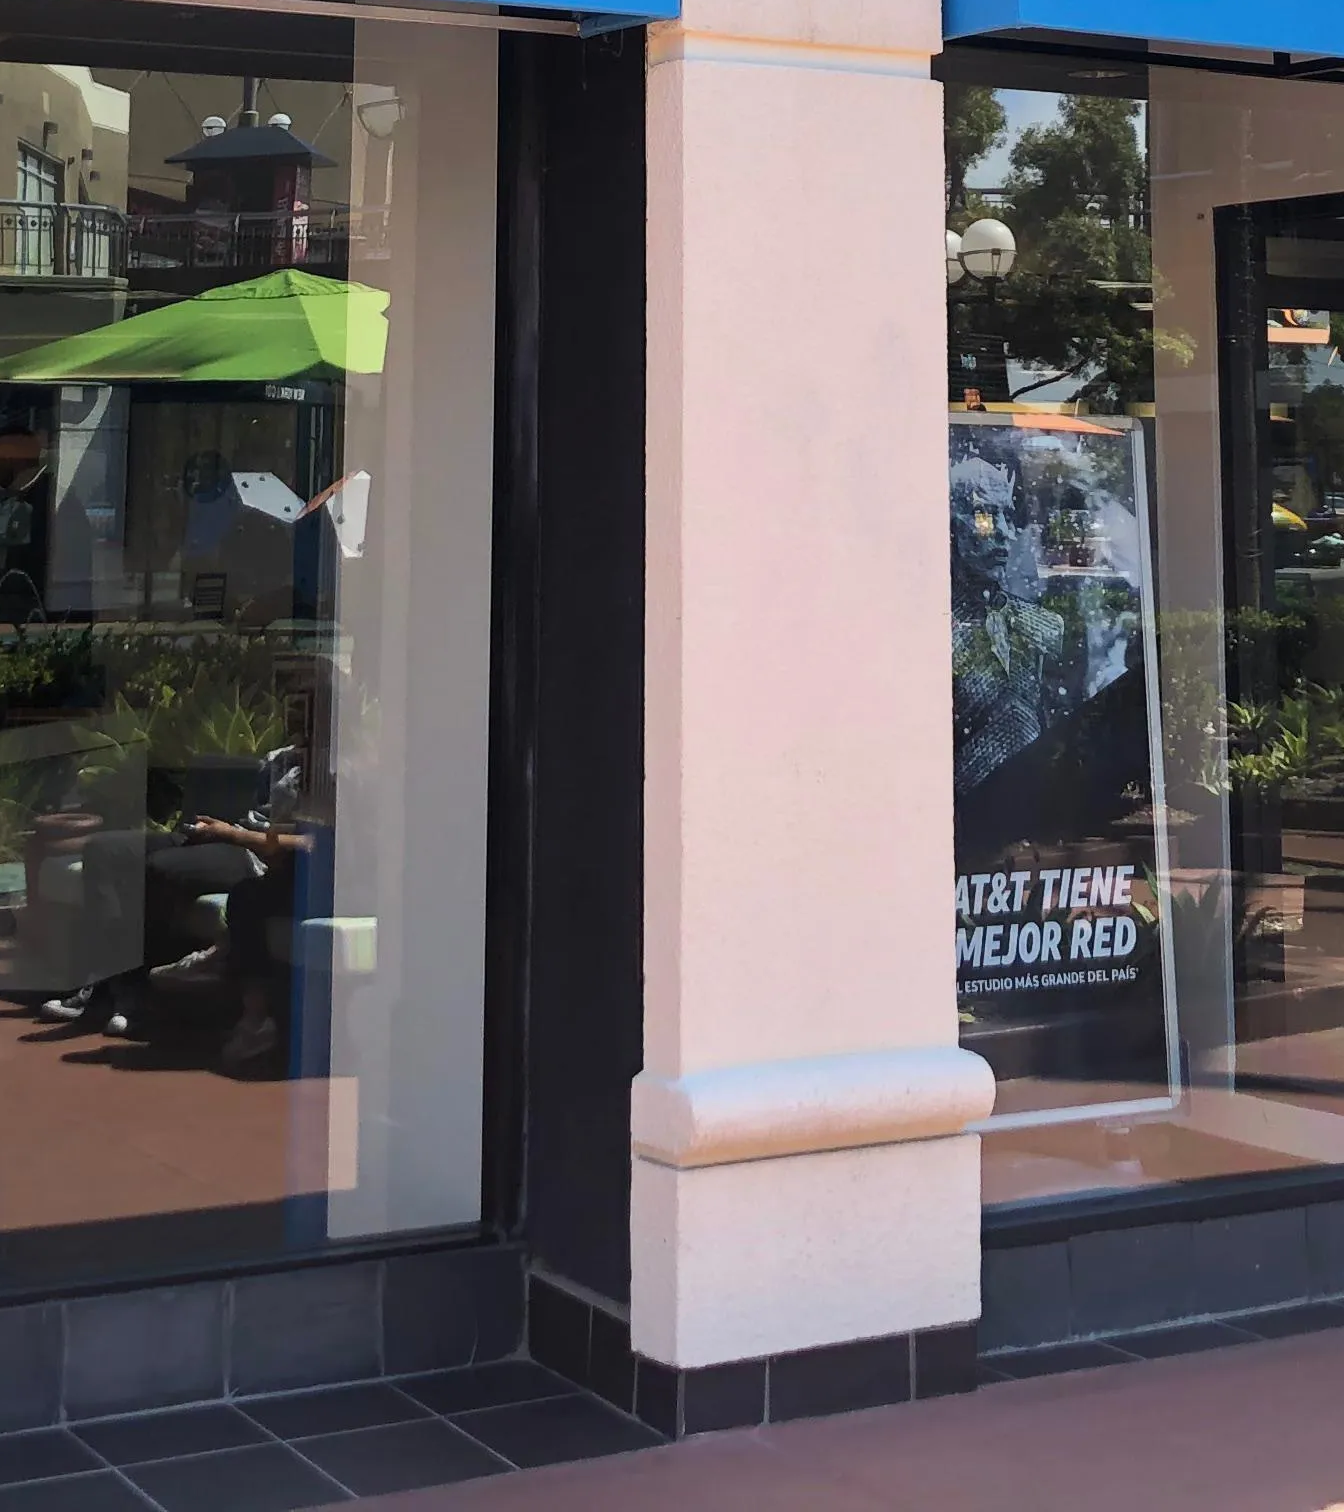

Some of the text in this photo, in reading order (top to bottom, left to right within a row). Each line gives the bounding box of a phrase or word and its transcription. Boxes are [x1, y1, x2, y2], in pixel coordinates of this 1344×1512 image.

[955, 865, 1135, 915] AT&T TIENE
[956, 916, 1137, 968] MEJOR RED
[965, 977, 1013, 993] ESTUDIO
[1015, 973, 1039, 989] MÁS
[1041, 970, 1086, 987] GRANDE
[1087, 969, 1109, 983] DEL
